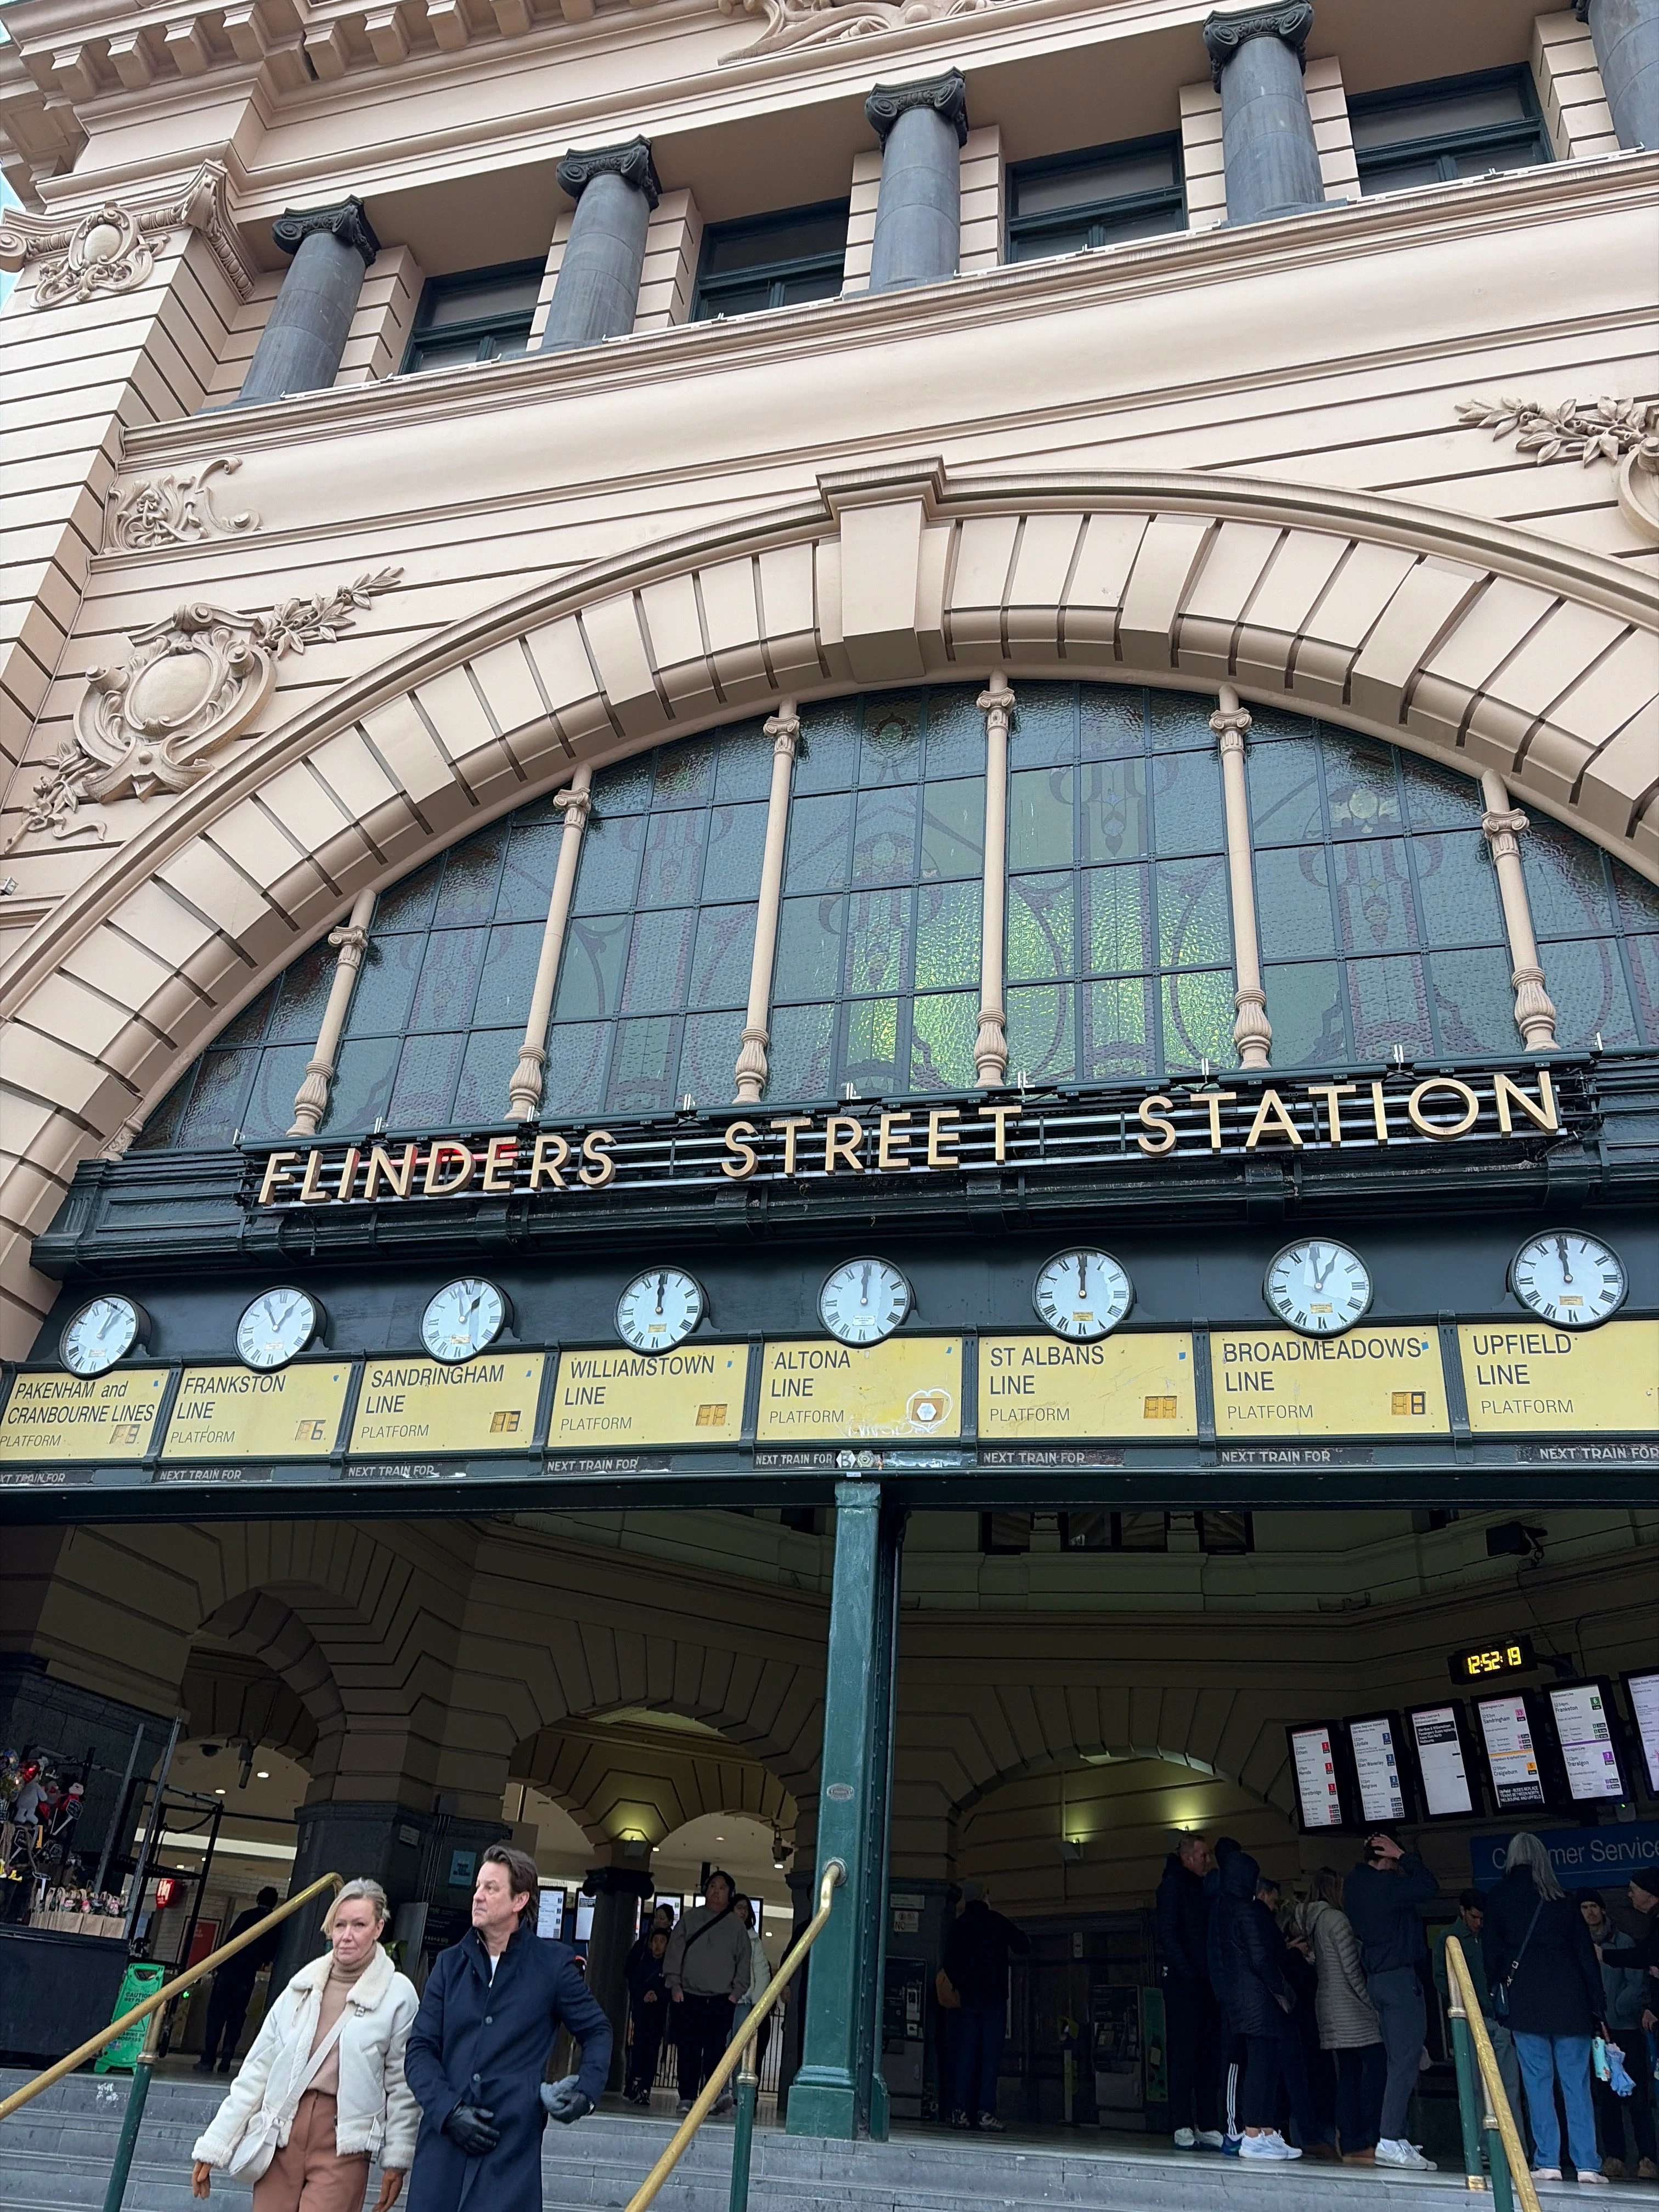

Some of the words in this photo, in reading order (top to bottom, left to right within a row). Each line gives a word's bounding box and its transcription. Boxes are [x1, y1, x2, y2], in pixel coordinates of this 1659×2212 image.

[258, 1130, 617, 1207] FLINDERS
[721, 1105, 1023, 1181] STREET
[1137, 1070, 1559, 1158] STATION
[1224, 1338, 1421, 1362] BROADMEADOWS
[1473, 1334, 1572, 1355] UPFIELD
[774, 1350, 850, 1369] ALTONA
[990, 1347, 1015, 1367] ST
[1022, 1346, 1104, 1366] ALBANS
[371, 1364, 504, 1387] SANDRINGHAM
[571, 1356, 714, 1378] WILLIAMSTOWN
[1477, 1364, 1530, 1385] LINE
[15, 1382, 95, 1399] PAKENHAM
[101, 1381, 128, 1397] and
[184, 1375, 286, 1394] FRANKSTON
[771, 1378, 814, 1397] LINE
[990, 1375, 1035, 1395] LINE
[1225, 1372, 1274, 1391] LINE
[366, 1395, 405, 1414] LINE
[565, 1386, 606, 1406] LINE
[8, 1405, 109, 1424] CRANBOURNE
[111, 1404, 155, 1422] LINES
[177, 1402, 215, 1419] LINE
[990, 1408, 1069, 1421] PLATFORM
[1228, 1404, 1313, 1419] PLATFORM
[1481, 1400, 1573, 1414] PLATFORM
[561, 1417, 632, 1431] PLATFORM
[770, 1410, 844, 1423] PLATFORM
[171, 1431, 235, 1443] PLATFORM
[362, 1425, 429, 1438] PLATFORM
[1, 1435, 61, 1447] PLATFORM
[755, 1454, 778, 1465] NEXT
[781, 1454, 810, 1464] TRAIN
[813, 1454, 832, 1464] FOR
[983, 1453, 1015, 1463] NEXT
[1018, 1453, 1057, 1463] TRAIN
[1060, 1453, 1085, 1463] FOR
[1222, 1452, 1256, 1462] NEXT
[1260, 1451, 1300, 1462] TRAIN
[1305, 1451, 1330, 1462] FOR
[1539, 1448, 1576, 1459] NEXT
[1580, 1447, 1627, 1459] TRAIN
[1630, 1447, 1659, 1458] FOR
[348, 1467, 376, 1477] NEXT
[379, 1466, 410, 1476] TRAIN
[413, 1465, 434, 1475] FOR
[548, 1460, 575, 1471] NEXT
[579, 1459, 613, 1471] TRAIN
[616, 1459, 637, 1470] FOR
[15, 1474, 46, 1483] TRAIN
[47, 1473, 65, 1482] FOR
[160, 1470, 188, 1480] NEXT
[190, 1469, 221, 1480] TRAIN
[222, 1470, 241, 1479] FOR
[1492, 1846, 1585, 1869] Cmer
